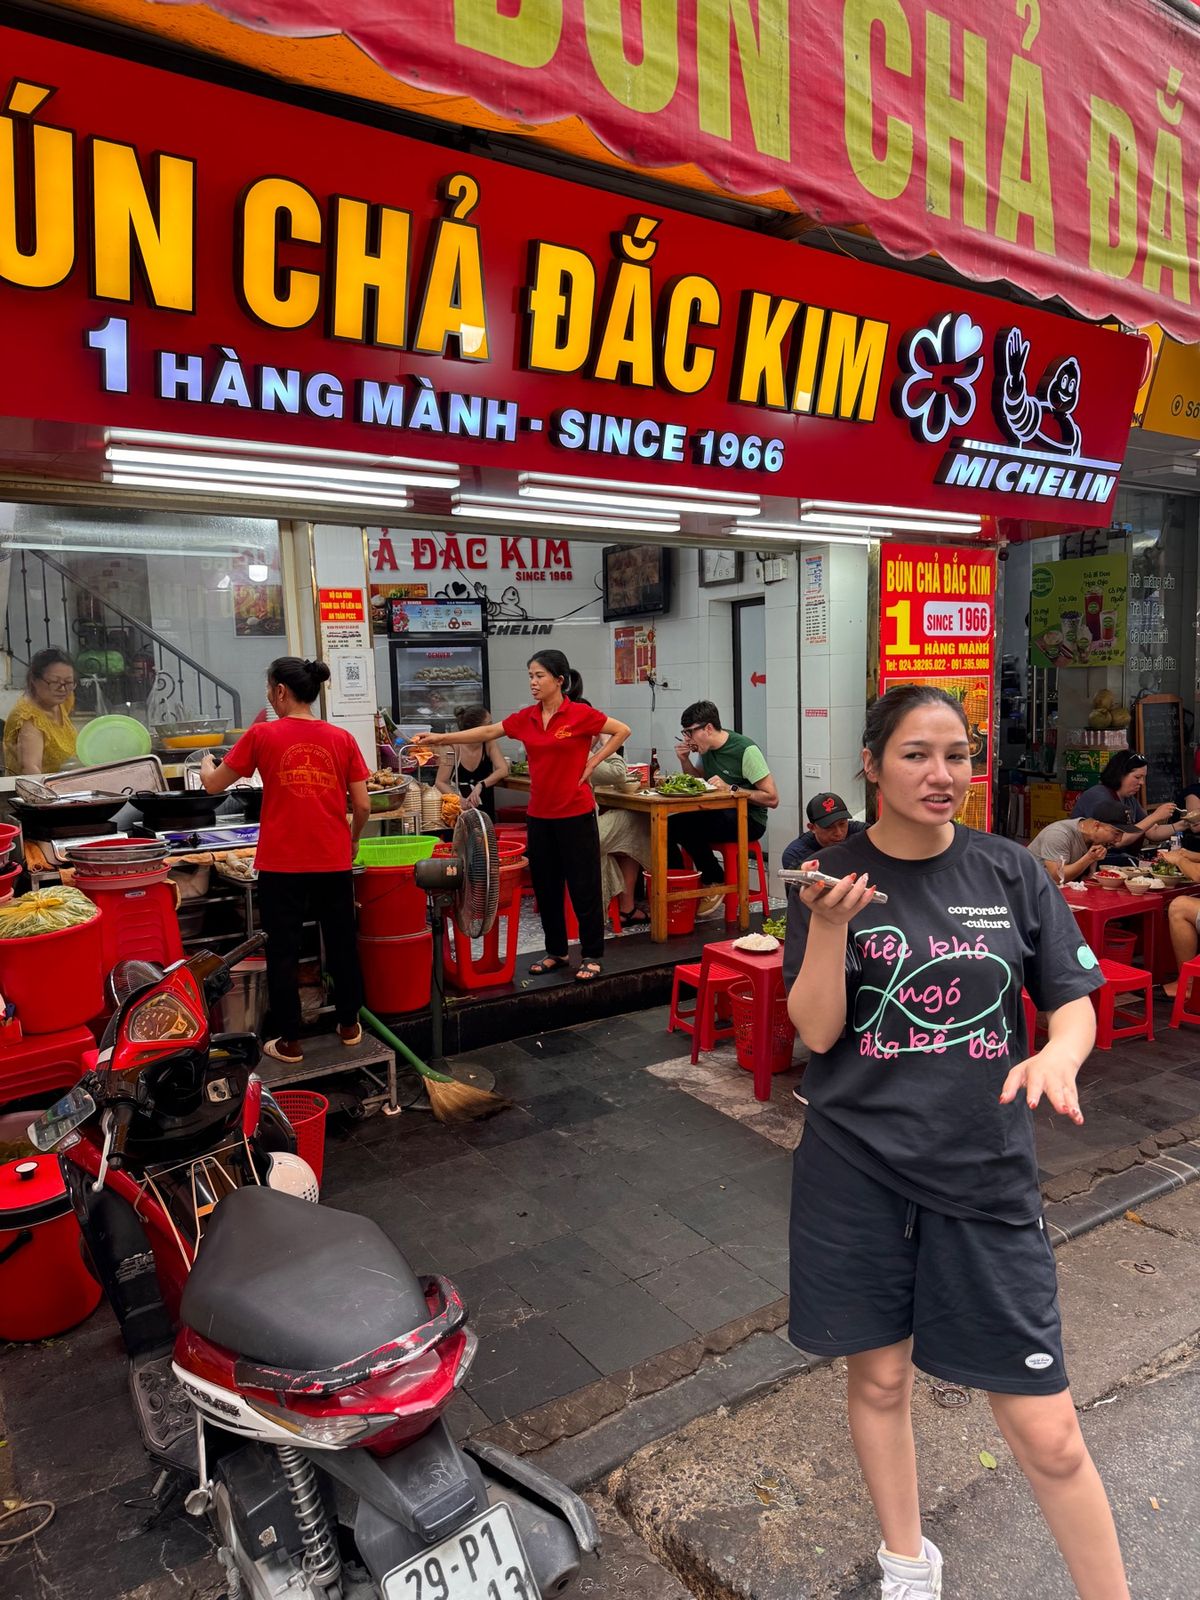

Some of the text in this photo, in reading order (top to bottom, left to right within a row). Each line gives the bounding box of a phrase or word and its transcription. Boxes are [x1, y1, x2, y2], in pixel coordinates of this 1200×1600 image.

[842, 0, 1056, 256] CHẢ
[1087, 66, 1200, 304] ĐẮ
[241, 173, 490, 361] CHẢ
[528, 216, 721, 394] ĐẮC
[739, 292, 889, 424] KIM
[88, 318, 128, 393] 1
[160, 347, 344, 419] HÀNG
[361, 375, 519, 442] MÀNH
[559, 408, 685, 461] SINCE
[699, 430, 785, 472] 1966
[944, 454, 1117, 504] MICHELIN
[500, 536, 572, 570] KIM
[516, 571, 573, 581] SINCE 1966
[886, 552, 991, 595] BÚN CHẢ ĐẮC KIM
[885, 600, 920, 655] 1
[926, 607, 988, 632] SINCE 1966
[924, 640, 990, 655] HÀNG MÀNH
[947, 906, 1008, 917] corporate
[928, 935, 989, 960] khó
[898, 978, 961, 1013] ngó
[909, 1017, 955, 1054] kế
